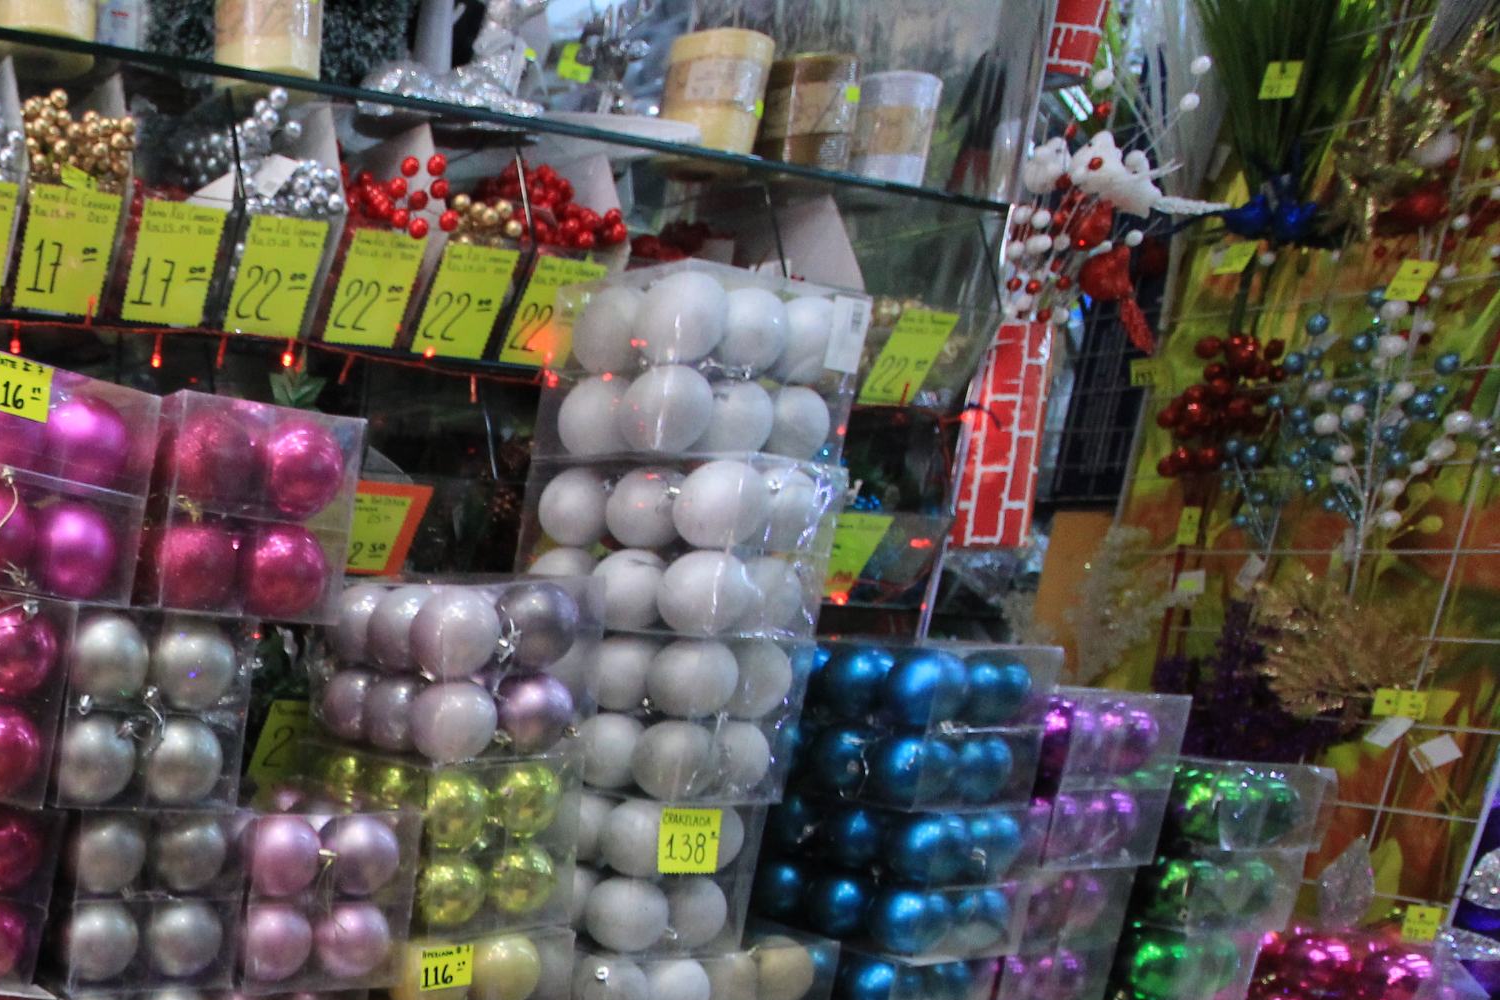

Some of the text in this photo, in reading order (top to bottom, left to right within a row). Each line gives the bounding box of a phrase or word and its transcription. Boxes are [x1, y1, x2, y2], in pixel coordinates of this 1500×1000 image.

[26, 239, 62, 294] 17
[129, 257, 175, 307] 17
[236, 265, 281, 321] 22
[334, 279, 381, 331] 22
[422, 291, 471, 341] 22
[509, 303, 553, 352] 22
[868, 355, 908, 393] 22
[665, 833, 707, 864] 138
[422, 965, 453, 988] 116
